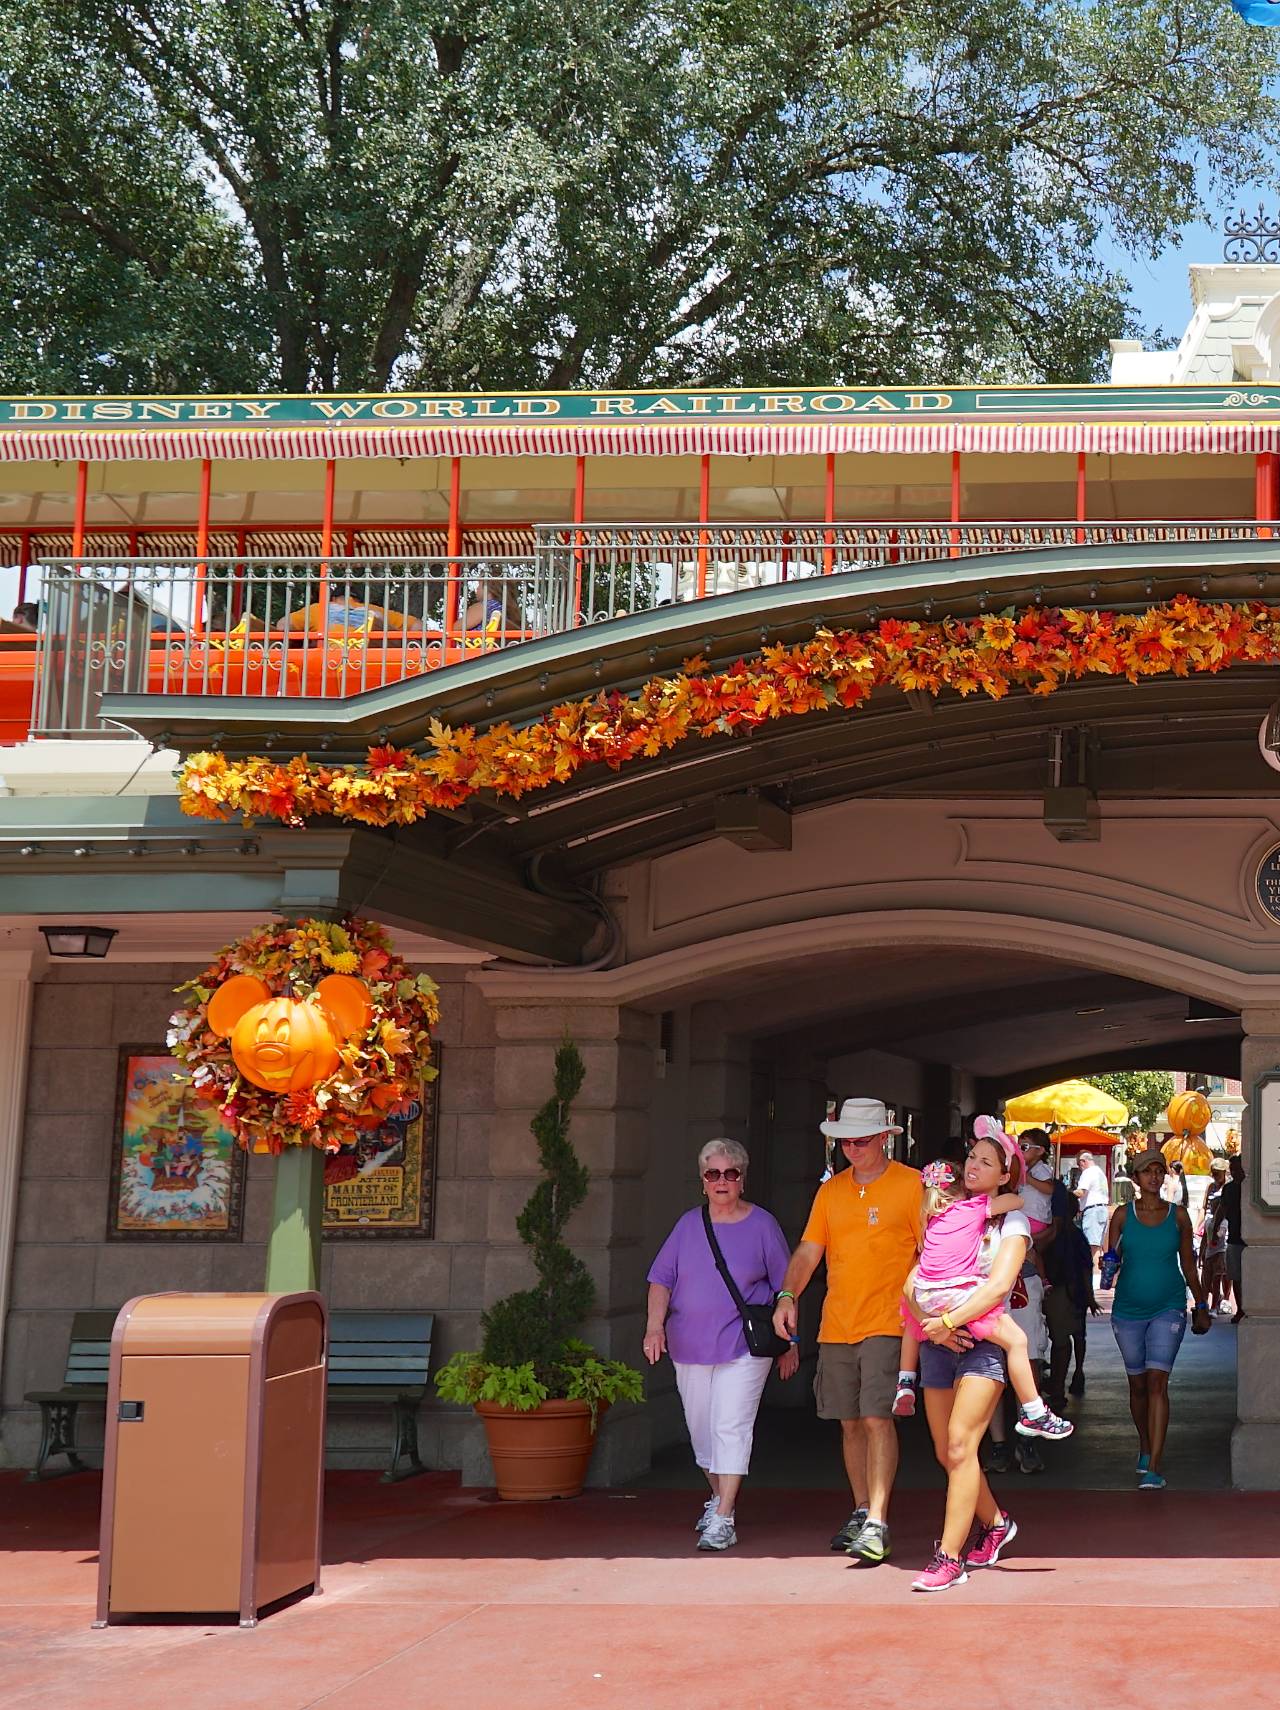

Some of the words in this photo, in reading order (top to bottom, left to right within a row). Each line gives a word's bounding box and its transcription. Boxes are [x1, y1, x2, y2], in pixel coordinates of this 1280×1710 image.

[8, 402, 281, 420] DISNEY
[310, 397, 561, 419] WORLD
[589, 393, 953, 415] RAILROAD
[330, 1196, 399, 1207] FRONTIERLAND
